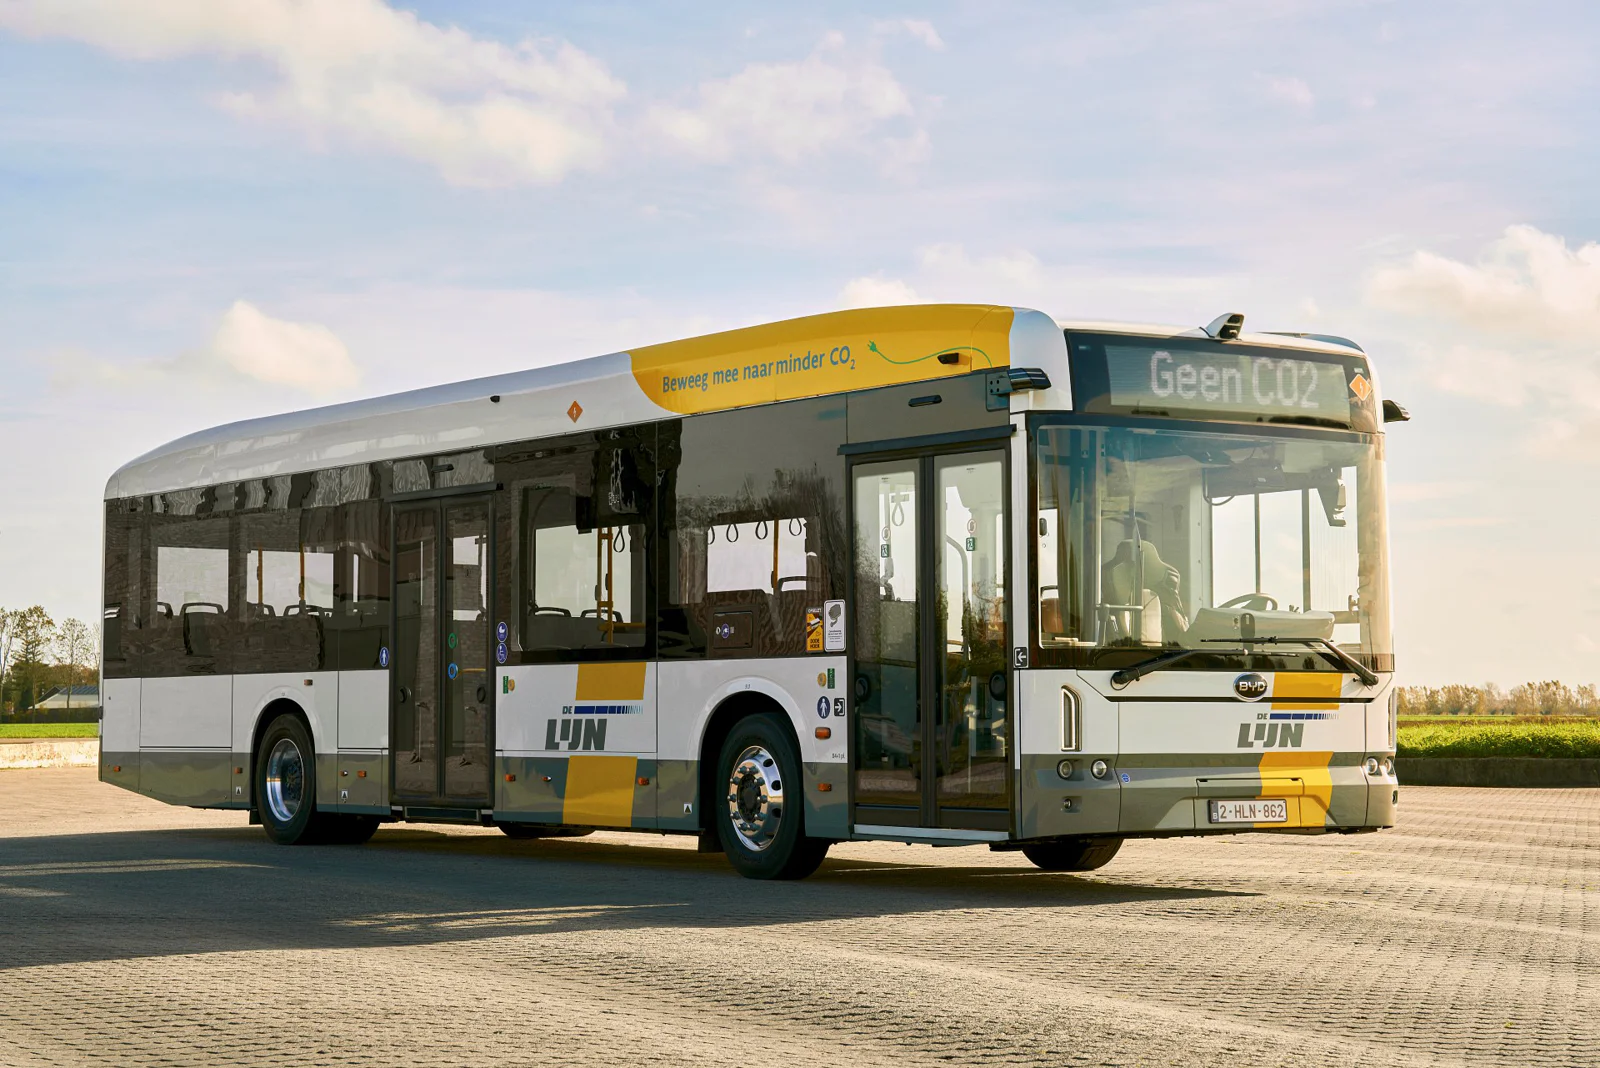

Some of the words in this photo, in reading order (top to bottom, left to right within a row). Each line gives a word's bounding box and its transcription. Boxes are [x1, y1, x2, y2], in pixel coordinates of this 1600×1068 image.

[662, 372, 709, 393] Beweeg
[713, 368, 739, 385] mee
[743, 361, 774, 380] naar
[776, 350, 826, 375] minder
[1150, 350, 1243, 404] Geen
[1252, 356, 1320, 409] CO2
[1239, 681, 1266, 691] BYD
[562, 705, 573, 714] DE
[544, 718, 608, 751] LIJN
[1237, 723, 1305, 748] LIJN
[1219, 804, 1284, 819] 2-HLN-862
